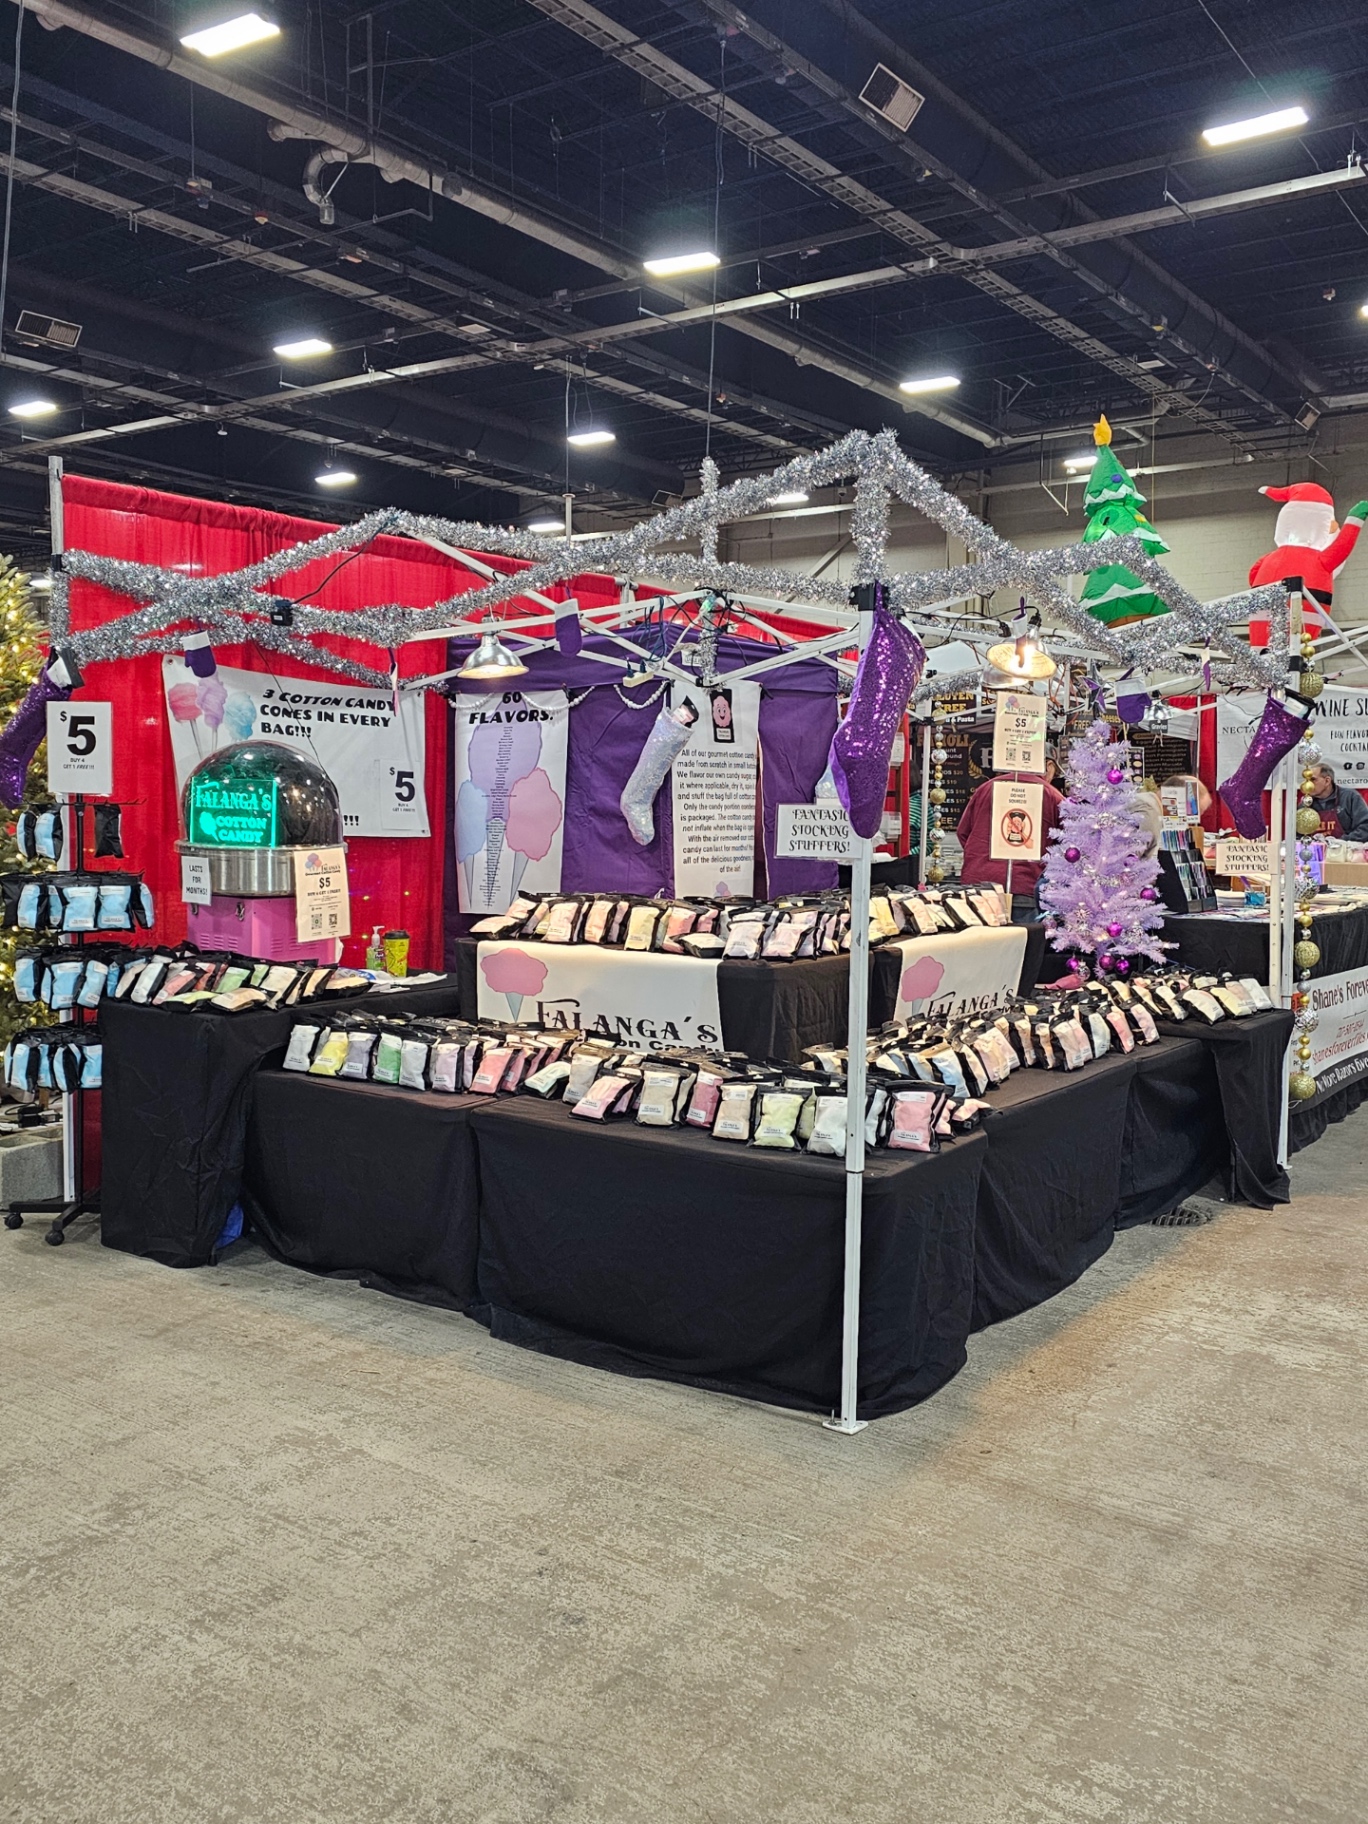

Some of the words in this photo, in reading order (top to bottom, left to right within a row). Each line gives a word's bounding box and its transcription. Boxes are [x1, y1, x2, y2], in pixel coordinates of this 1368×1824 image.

[263, 689, 275, 699] 3
[279, 692, 343, 707] COTTON
[345, 698, 395, 712] CANDY
[502, 691, 521, 704] 60
[1315, 699, 1349, 717] WINE
[260, 704, 312, 721] CONES
[317, 711, 334, 723] IN
[340, 713, 391, 728] EVERY
[469, 709, 554, 724] FLAVORS.
[1015, 717, 1027, 728] $5
[261, 722, 312, 738] BAG!!!
[1222, 726, 1258, 735] NECTA
[681, 749, 690, 757] All
[195, 781, 272, 811] FALANGA'S
[677, 792, 690, 800] and
[691, 792, 705, 800] stuff
[705, 792, 714, 800] the
[683, 803, 697, 811] Only
[708, 803, 723, 811] candy
[724, 803, 740, 811] portion
[216, 816, 267, 829] COTTON
[694, 824, 712, 832] inflate
[219, 830, 264, 843] CANDY
[791, 825, 849, 839] STOCKING
[682, 846, 701, 854] candy
[789, 840, 850, 853] STUFFERS!
[1226, 854, 1268, 863] STOCKING
[189, 865, 203, 873] LASTS
[719, 865, 725, 873] of
[192, 876, 202, 884] FOR
[319, 877, 331, 889] $5
[186, 887, 208, 896] MONTHS!
[1312, 984, 1344, 1011] Shane's
